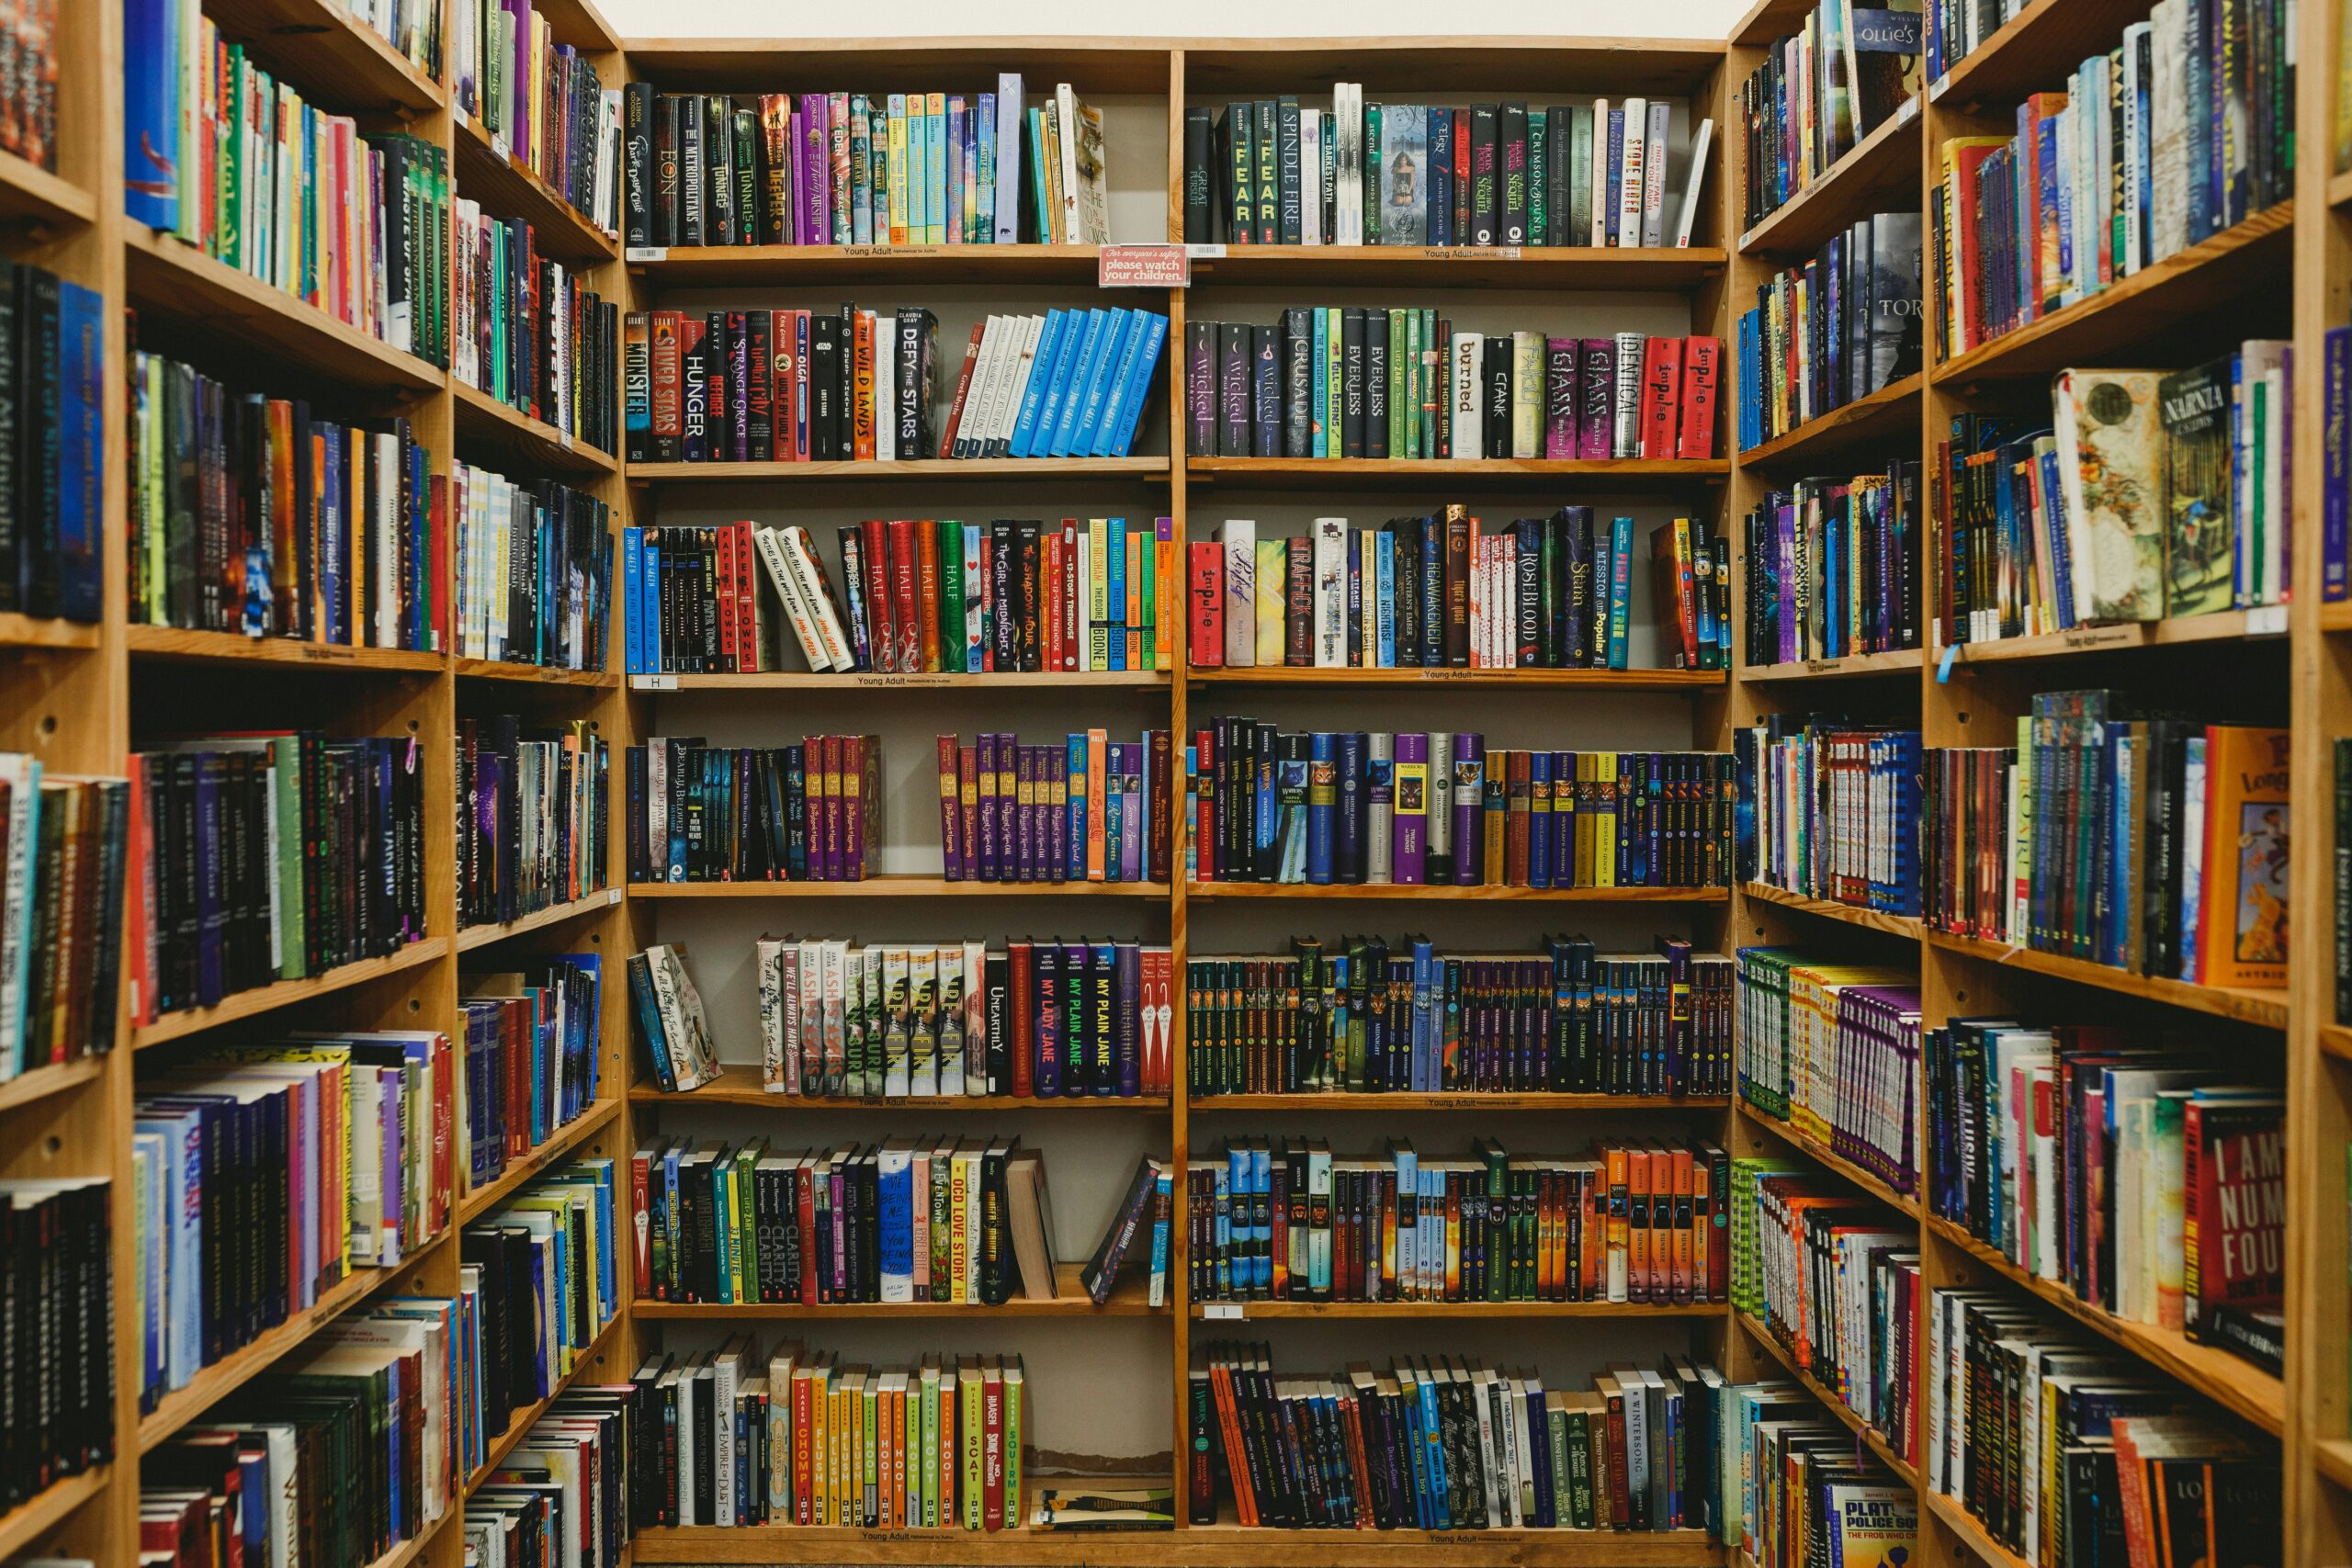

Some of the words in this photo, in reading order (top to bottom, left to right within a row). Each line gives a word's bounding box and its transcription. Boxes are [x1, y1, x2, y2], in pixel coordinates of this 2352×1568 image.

[1283, 114, 1297, 184] SPINDLE
[1325, 145, 1334, 182] DARKEST
[1532, 127, 1542, 187] CRIMSON
[661, 150, 678, 197] EON
[685, 141, 698, 222] METROPOLITANS
[768, 169, 786, 217] DEEPER
[737, 166, 753, 221] TUNNELS
[1284, 189, 1299, 226] FIRE
[1325, 184, 1333, 203] PATH
[844, 247, 869, 256] Young
[872, 247, 892, 255] Adult
[1106, 261, 1142, 272] please
[1146, 261, 1180, 270] watch
[1104, 272, 1131, 282] your
[1133, 270, 1182, 280] children.
[654, 336, 675, 383] SILVER
[903, 329, 917, 369] DEFY
[687, 356, 704, 437] HUNGER
[1196, 358, 1214, 421] Wicked
[1229, 360, 1247, 423] Wicked
[1264, 367, 1279, 423] Wicked
[1295, 340, 1308, 424] CRUSADE
[1345, 345, 1361, 415] EVERLESS
[1369, 346, 1384, 417] EVERLESS
[1460, 342, 1476, 413] burned
[656, 389, 675, 433] STARS
[902, 389, 916, 438] STARS
[872, 565, 884, 601] HALF
[899, 565, 910, 600] HALF
[899, 565, 910, 601] HALF
[946, 565, 957, 600] HALF
[1521, 553, 1538, 641] ROSEBLOOD
[1427, 562, 1442, 645] REAWAKENED
[651, 678, 660, 688] H
[857, 678, 883, 686] Young
[1424, 671, 1449, 679] Young
[990, 987, 1003, 1053] UNEARTHLY
[1042, 998, 1053, 1024] LADY
[1069, 999, 1080, 1032] PLAIN
[1097, 999, 1109, 1032] PLAIN
[1042, 1027, 1054, 1063] JANE
[1069, 1033, 1080, 1066] JANE
[1097, 1035, 1109, 1066] JANE
[953, 1178, 964, 1205] OCD
[953, 1208, 964, 1239] LOVE
[953, 1243, 964, 1282] STORY
[2224, 1230, 2285, 1277] FOU
[863, 1532, 887, 1540] Young
